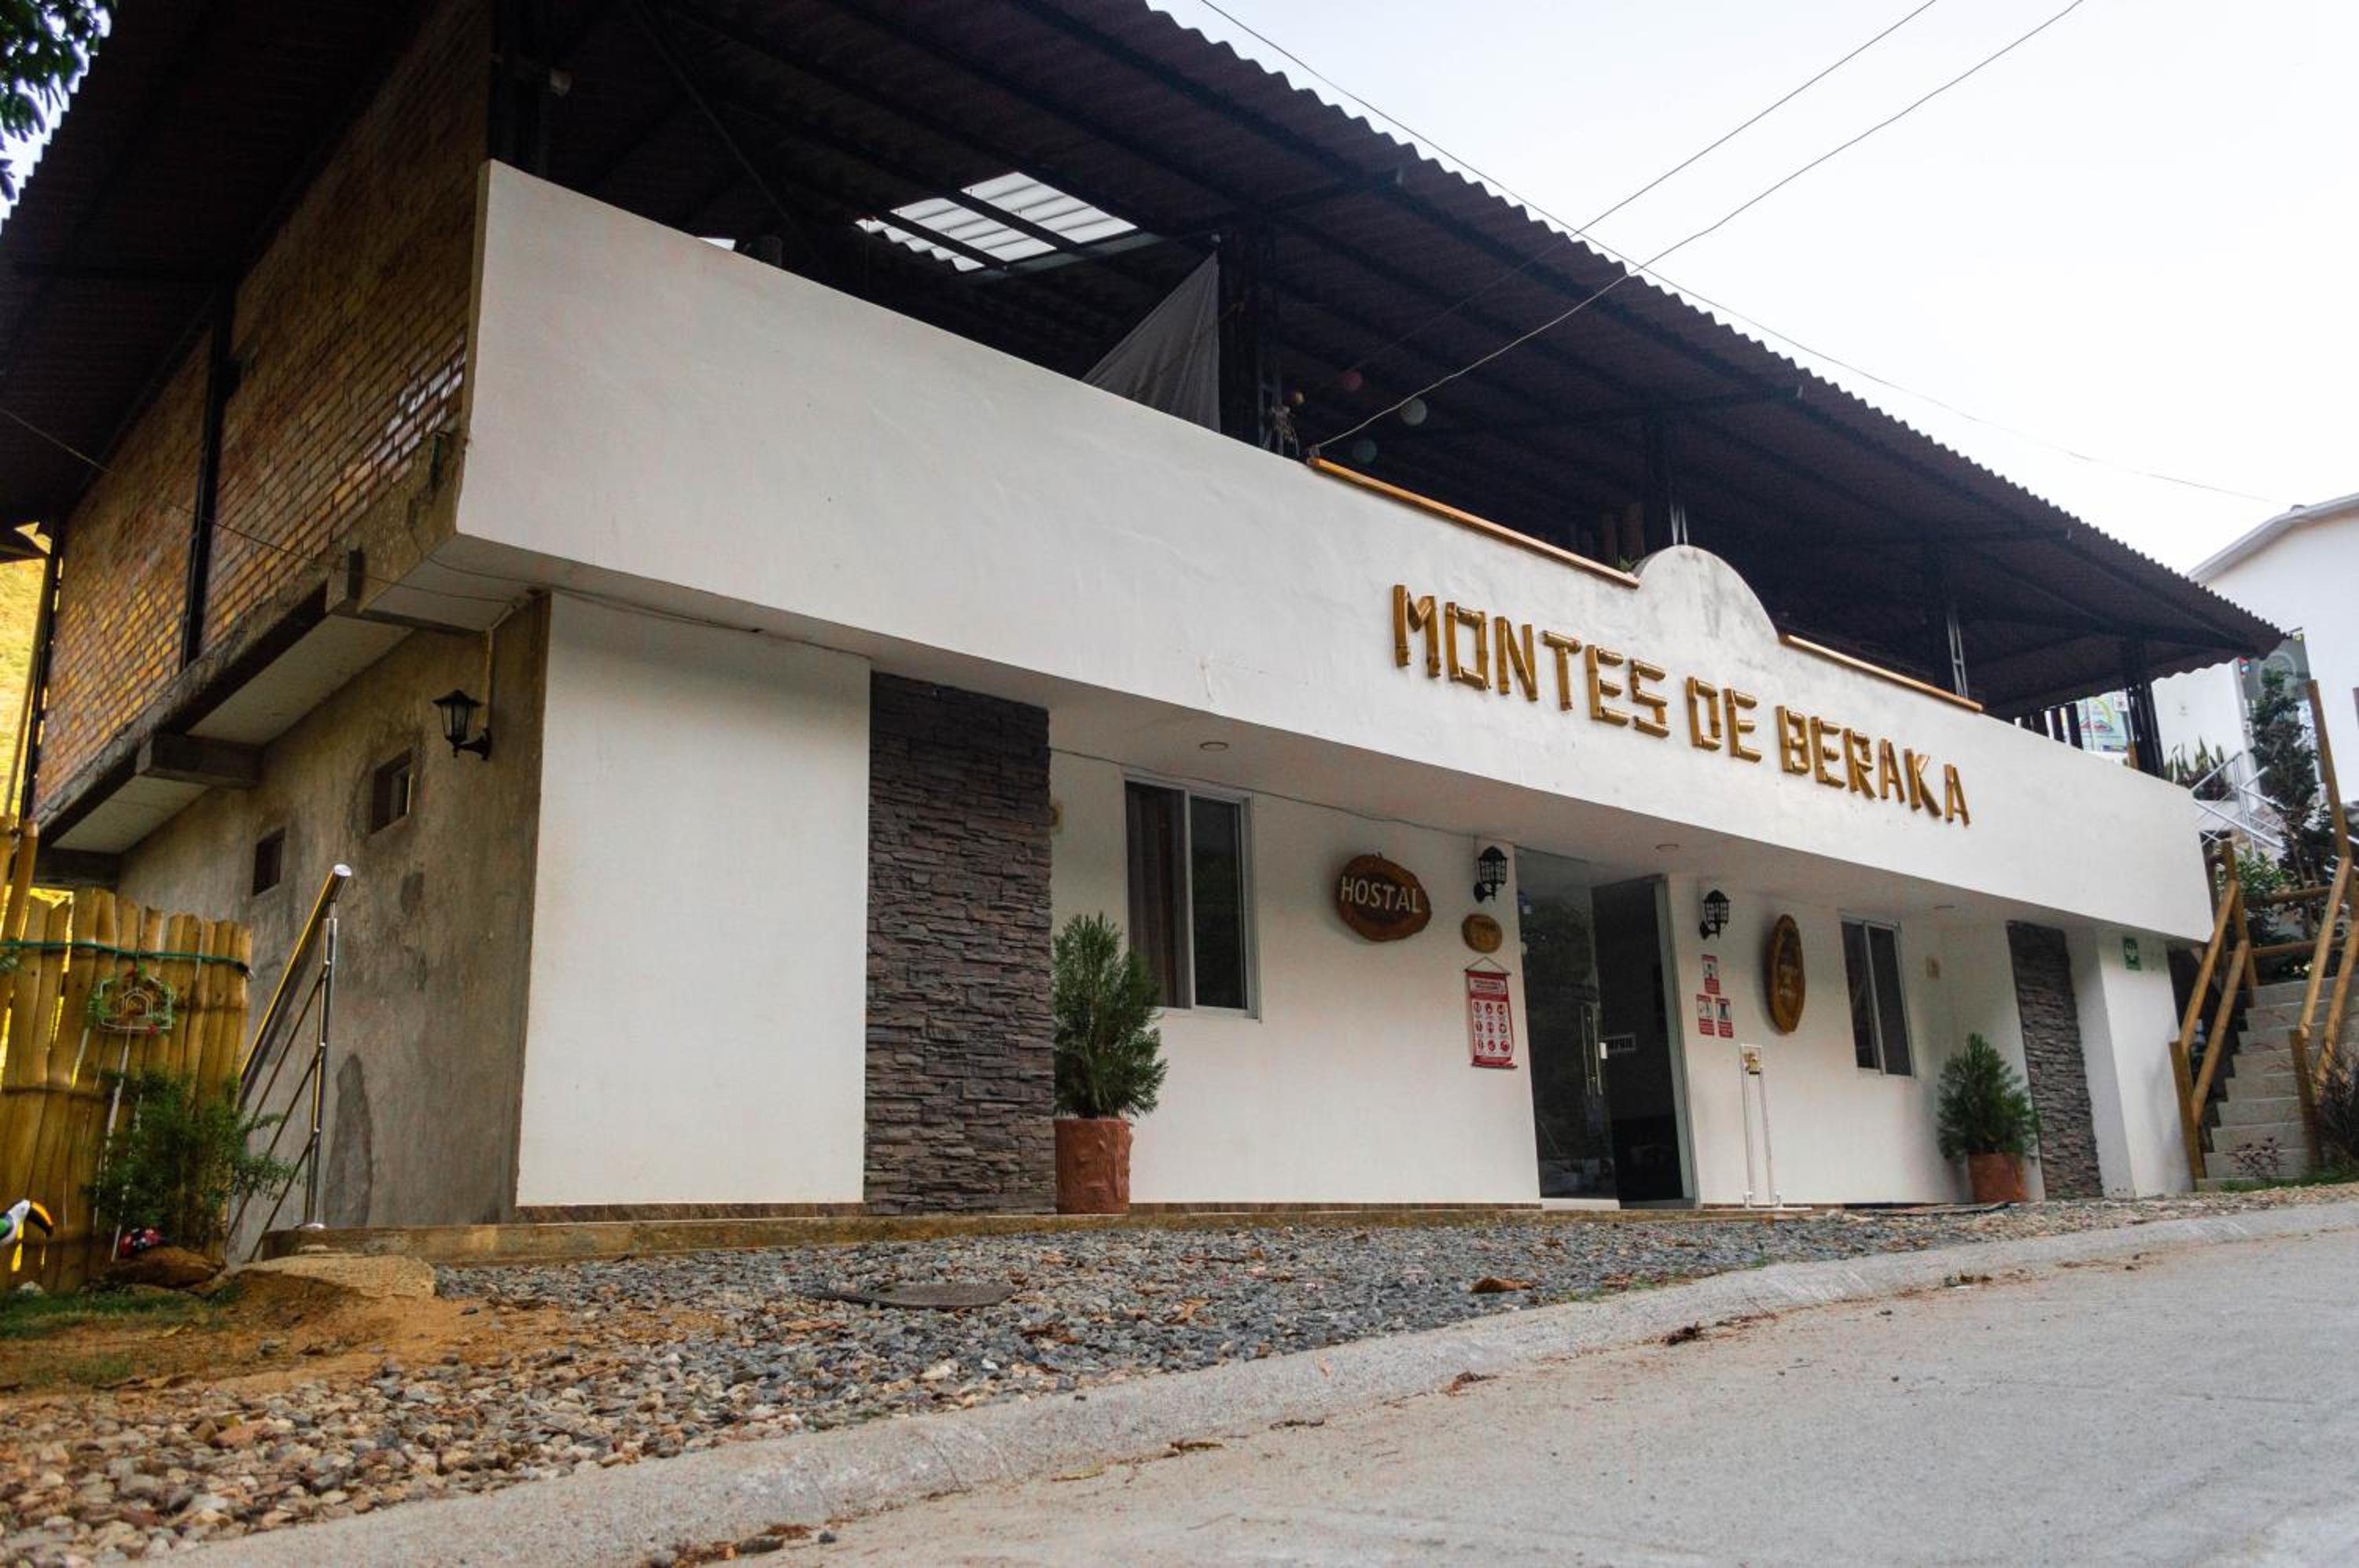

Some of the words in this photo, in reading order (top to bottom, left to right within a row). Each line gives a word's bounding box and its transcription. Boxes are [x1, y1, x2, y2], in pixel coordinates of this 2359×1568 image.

[1393, 584, 1670, 738] MONTES
[1686, 676, 1761, 762] DE
[1775, 705, 1969, 826] BERAKA
[1341, 875, 1422, 914] HOSTAL
